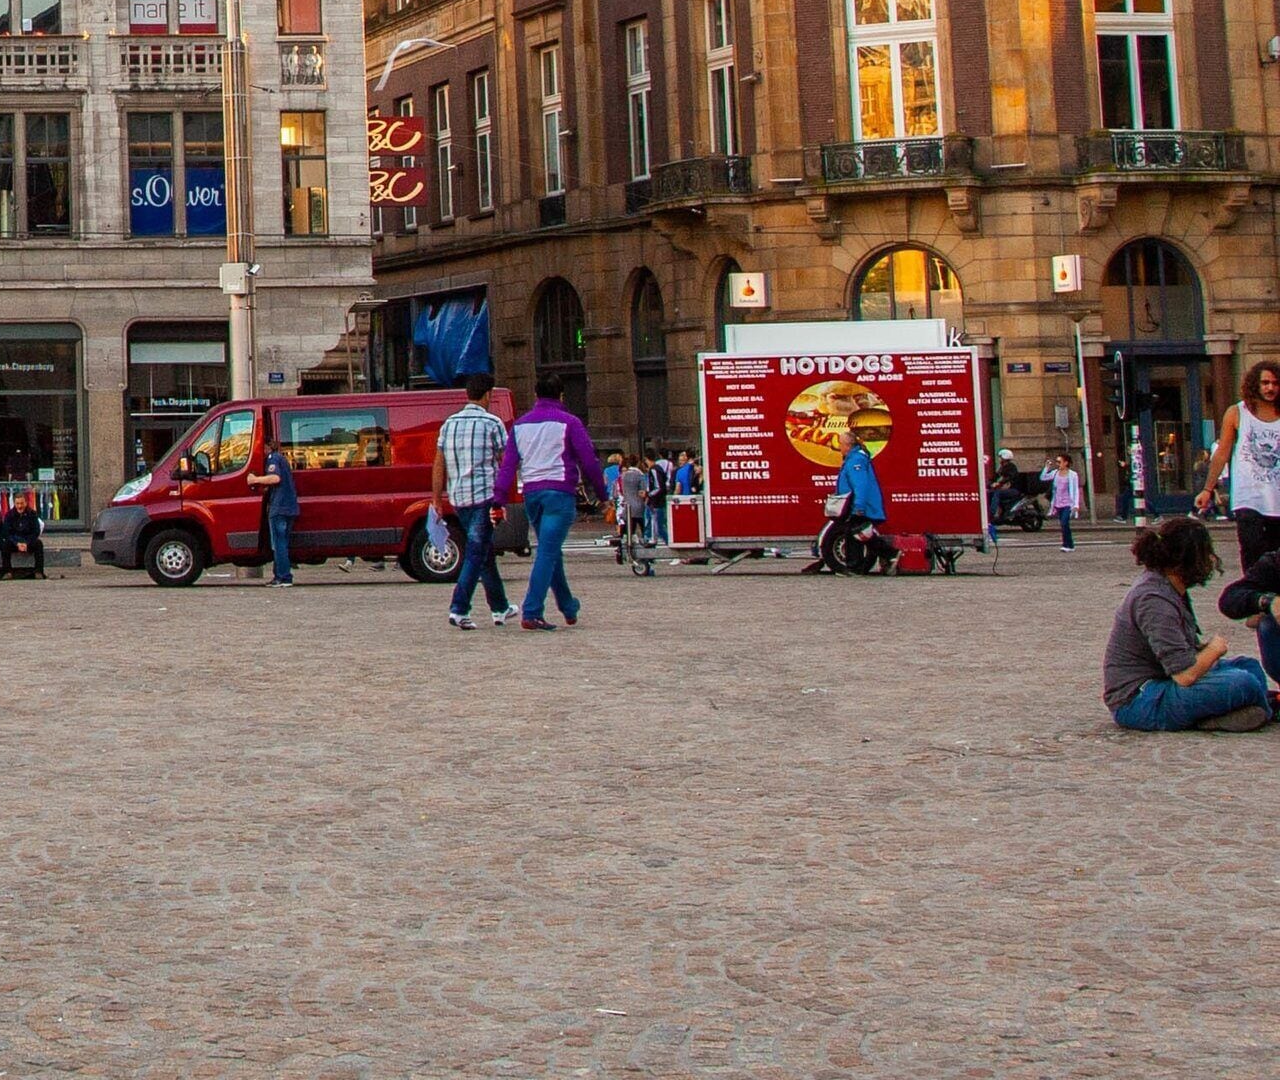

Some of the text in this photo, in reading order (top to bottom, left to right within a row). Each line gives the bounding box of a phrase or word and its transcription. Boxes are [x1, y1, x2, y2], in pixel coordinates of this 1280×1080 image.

[780, 355, 894, 376] HOTDOGS
[856, 373, 904, 382] AND MORE
[721, 460, 769, 469] ICE COLD
[917, 457, 968, 466] ICE COLD
[721, 471, 770, 480] DRINKS
[918, 468, 968, 477] DRINKS
